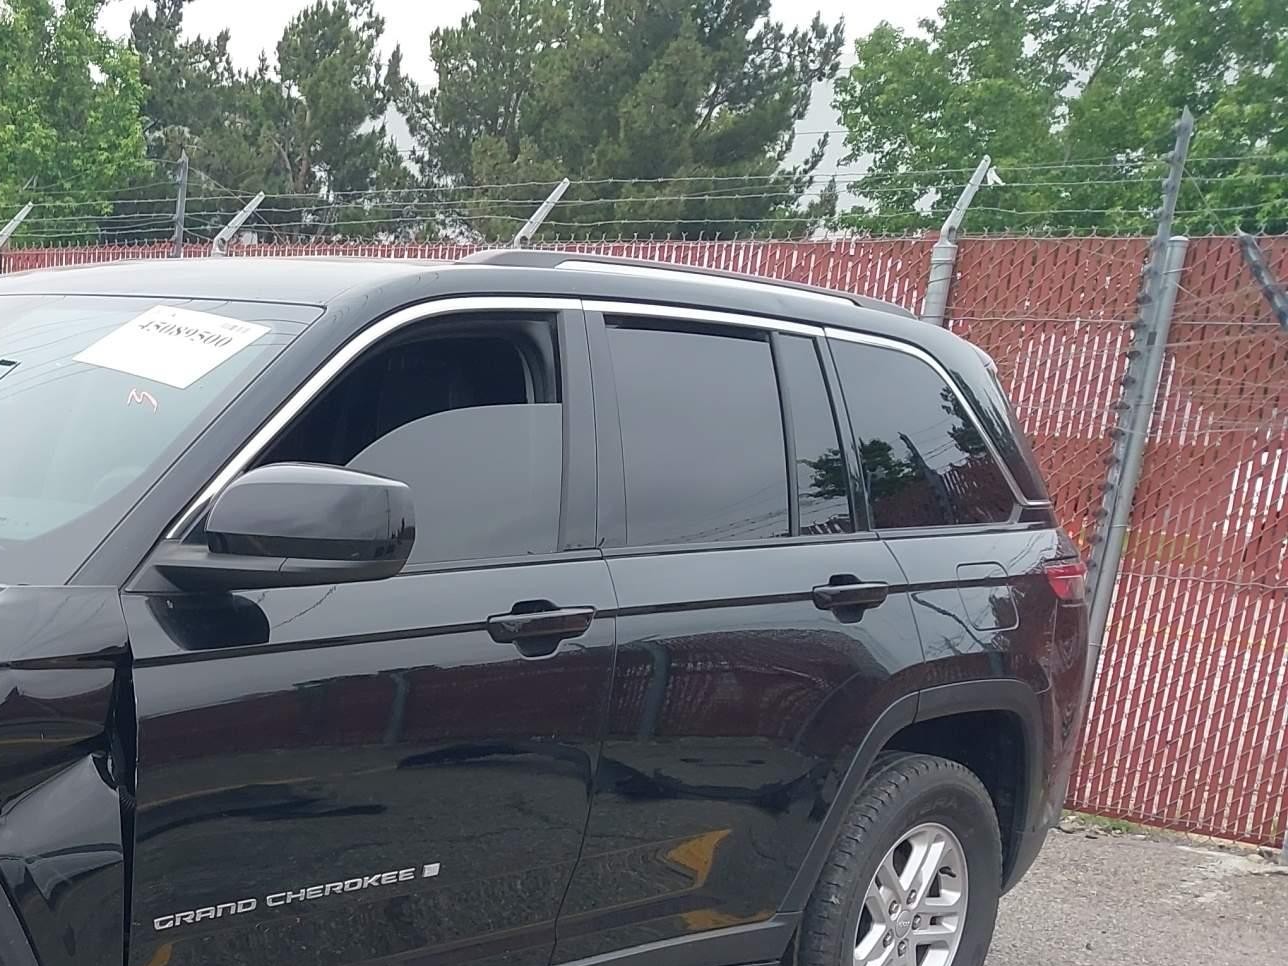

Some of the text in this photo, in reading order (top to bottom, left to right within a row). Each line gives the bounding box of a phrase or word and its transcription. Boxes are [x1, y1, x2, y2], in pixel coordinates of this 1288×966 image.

[138, 321, 233, 347] 45089500
[153, 867, 416, 931] GRAND CHEROKEE
